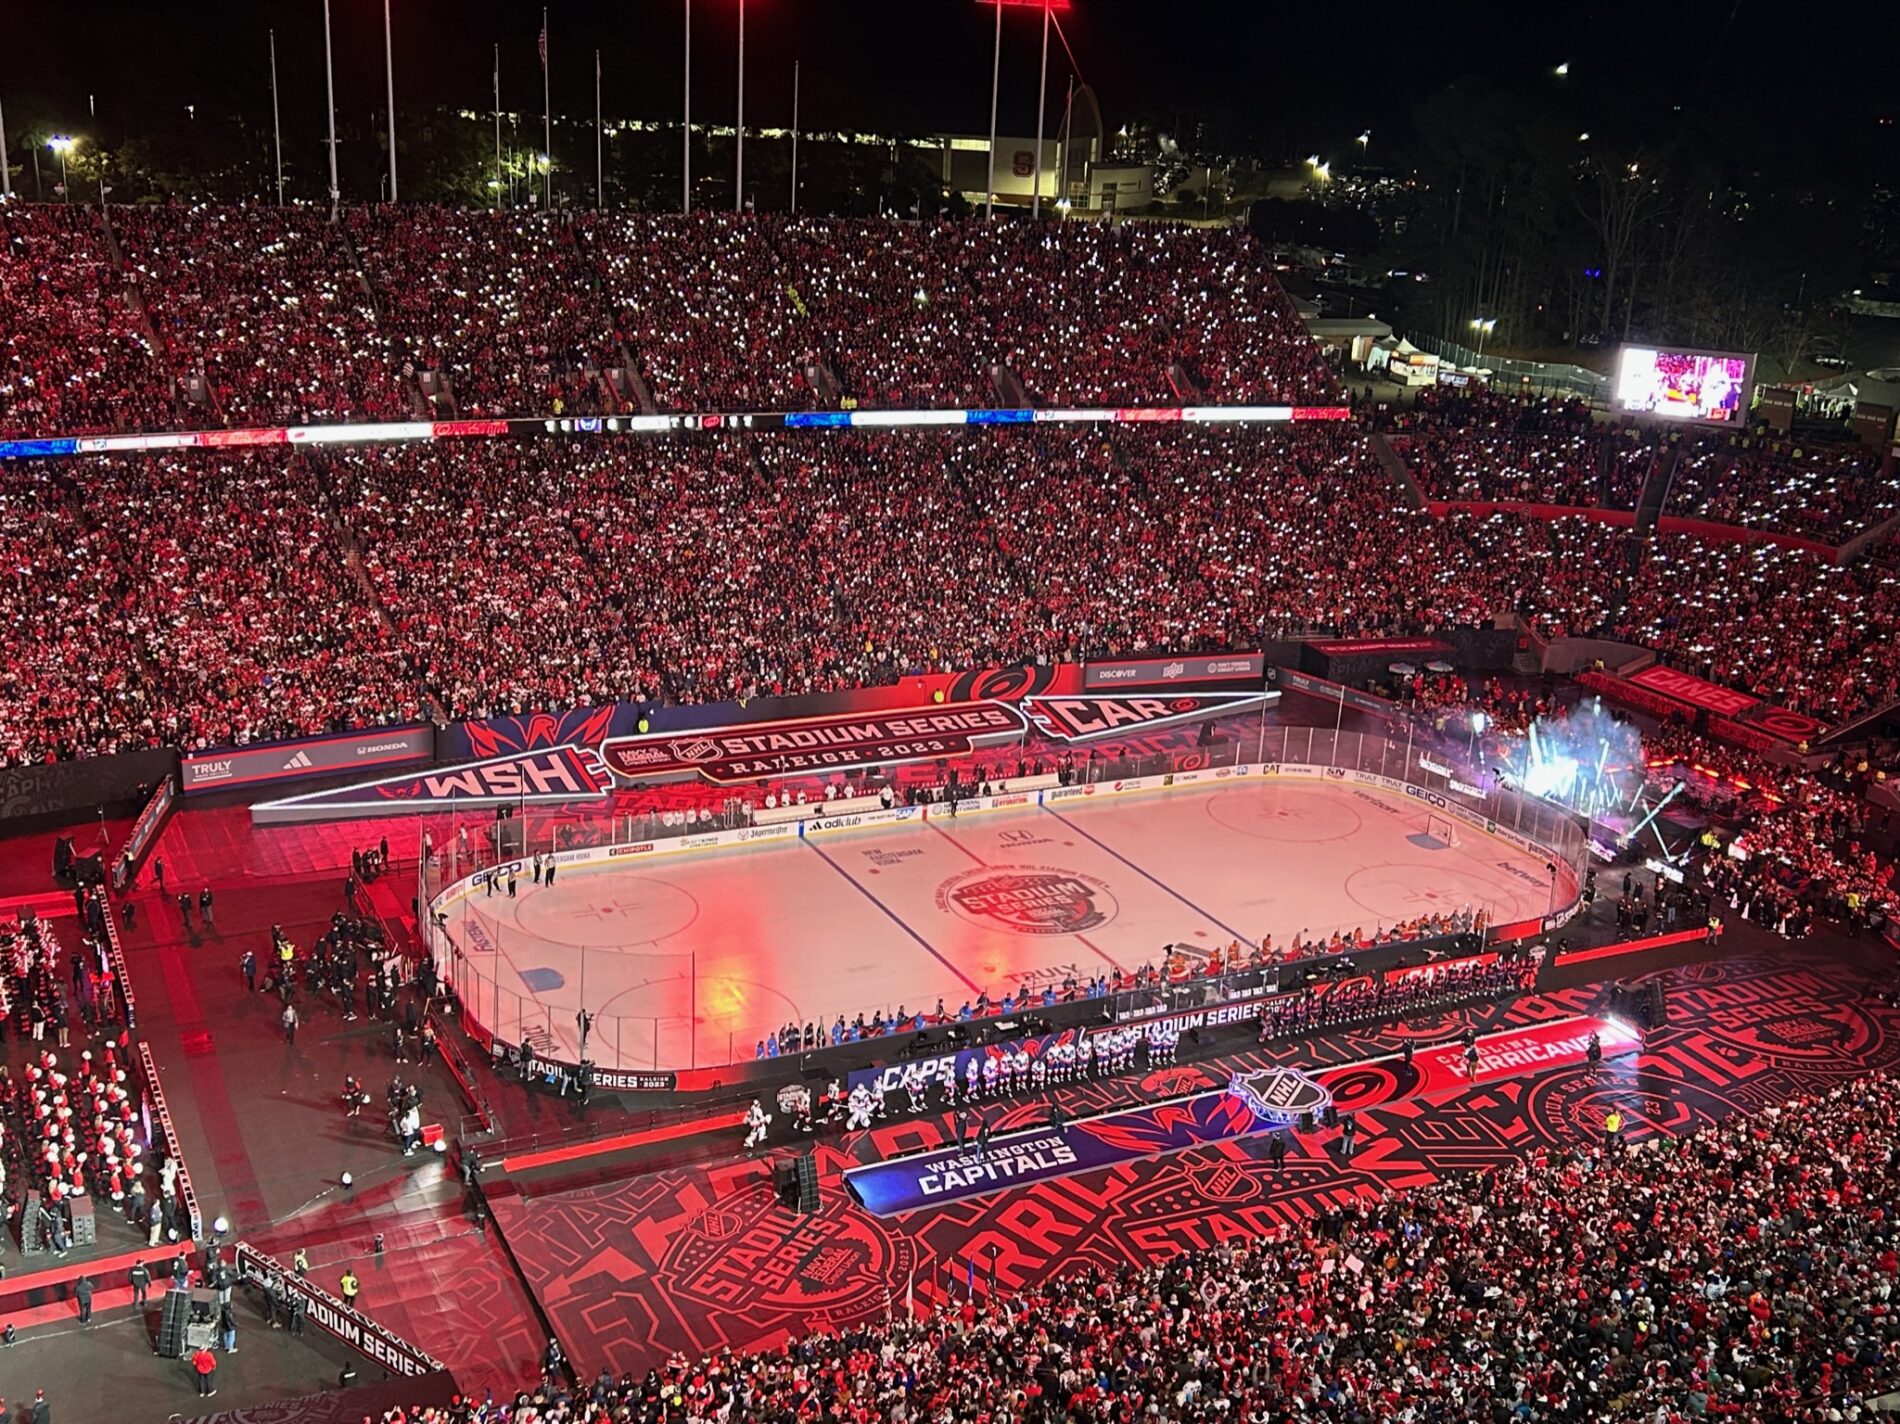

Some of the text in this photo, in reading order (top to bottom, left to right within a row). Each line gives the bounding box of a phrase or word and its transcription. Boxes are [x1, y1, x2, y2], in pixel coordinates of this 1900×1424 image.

[1099, 669, 1137, 680] DISCOVER
[1638, 670, 1750, 713] CANES
[1048, 699, 1173, 734] CAR
[720, 710, 1010, 754] STADIUM SERIES
[367, 742, 408, 753] HONDA
[686, 743, 708, 759] NHL
[729, 740, 945, 774] RALEIGH 2023
[192, 760, 232, 774] TRULY
[424, 754, 581, 797] WSH
[1263, 764, 1281, 775] CAT
[1051, 787, 1083, 800] guaranteed
[1406, 785, 1446, 809] GEICO
[824, 816, 861, 830] adiclub
[896, 808, 915, 820] SAP
[619, 844, 654, 854] CHIPOTLE
[1497, 862, 1551, 888] betway
[961, 882, 1085, 909] STADIUM
[996, 895, 1074, 913] SERIES
[1003, 963, 1079, 984] TRULY
[1665, 971, 1839, 1021] STADIUM
[1206, 1001, 1263, 1027] SERIES
[1705, 996, 1834, 1029] SERIES
[883, 1056, 956, 1092] CAPS
[1270, 1077, 1298, 1106] NHL
[925, 1136, 1065, 1174] WASHINGTON
[918, 1146, 1078, 1195] CAPITALS
[1210, 1169, 1237, 1196] NHL
[709, 1214, 721, 1237] NHL
[751, 1217, 841, 1290] SERIES
[800, 1254, 826, 1279] NAVY
[810, 1247, 848, 1282] FEDERAL
